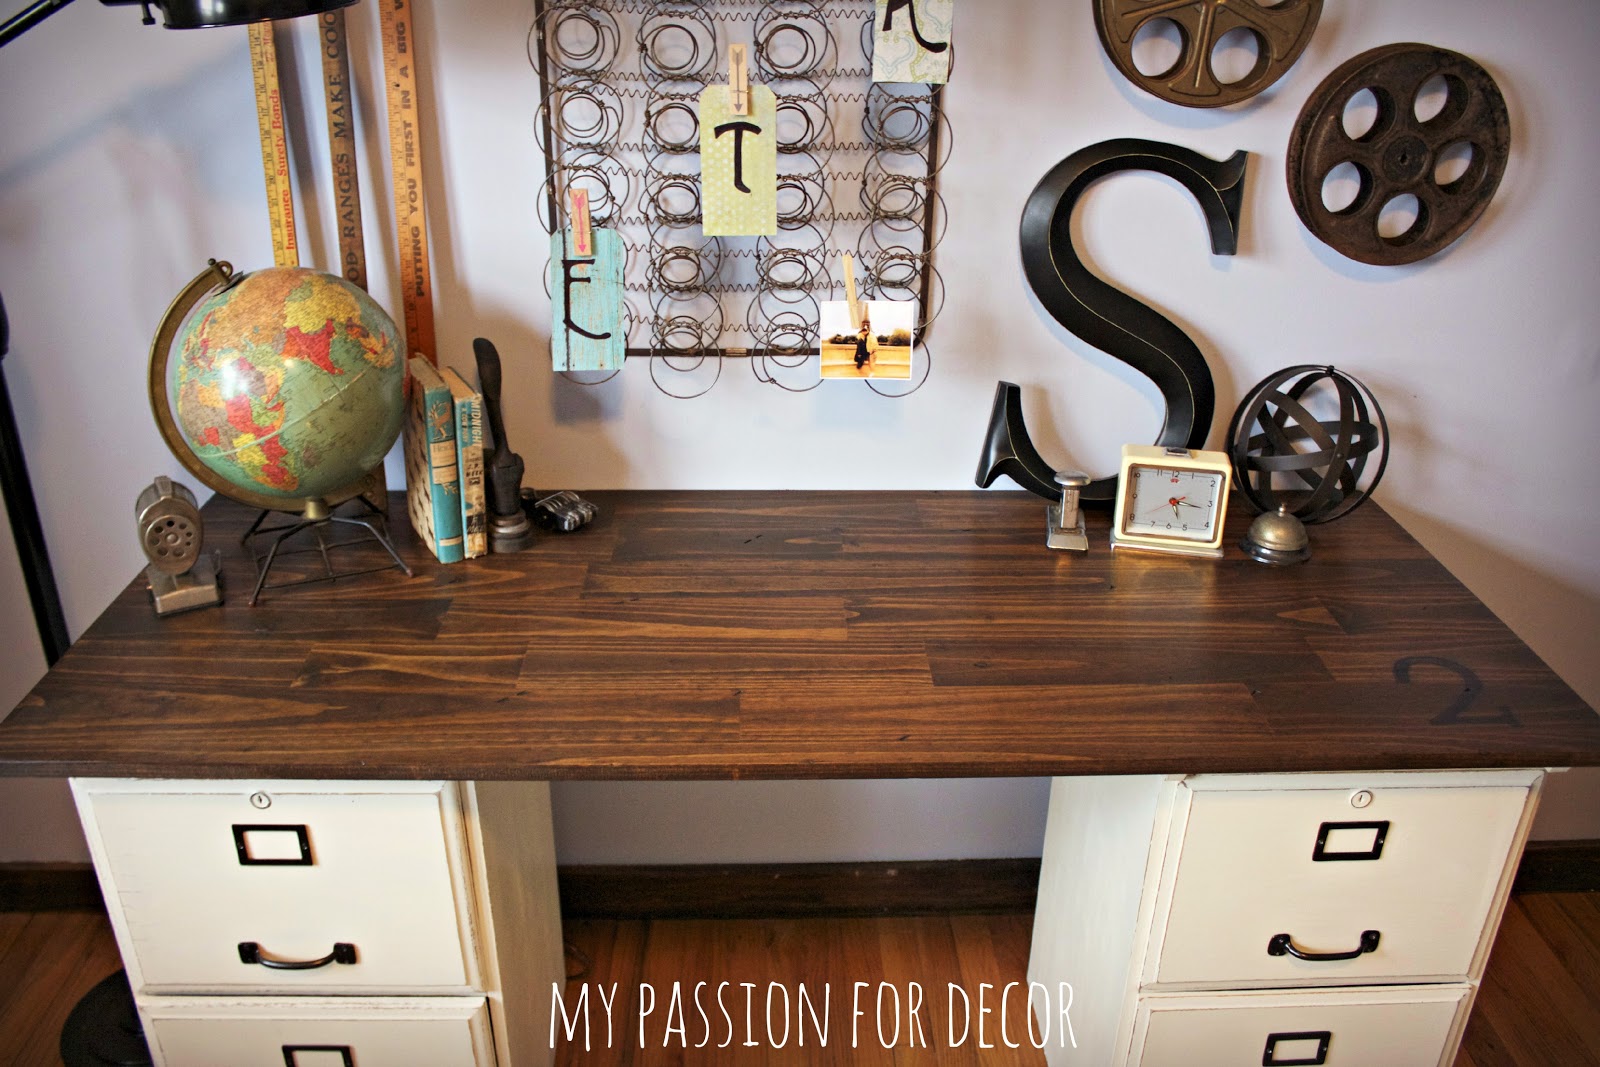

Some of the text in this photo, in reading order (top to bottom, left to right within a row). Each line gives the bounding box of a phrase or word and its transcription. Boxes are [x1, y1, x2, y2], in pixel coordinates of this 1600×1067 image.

[396, 21, 407, 54] BIG
[400, 65, 409, 78] A
[329, 73, 348, 138] MAKE
[400, 90, 411, 110] IN
[269, 88, 294, 250] Insurance Surety Bonds
[402, 120, 415, 167] FIRST
[714, 121, 762, 194] T
[336, 153, 356, 238] RANGES
[406, 178, 418, 215] YOU
[410, 226, 425, 297] PUTTING
[562, 258, 612, 340] E
[975, 137, 1248, 500] S
[1392, 656, 1522, 728] 2
